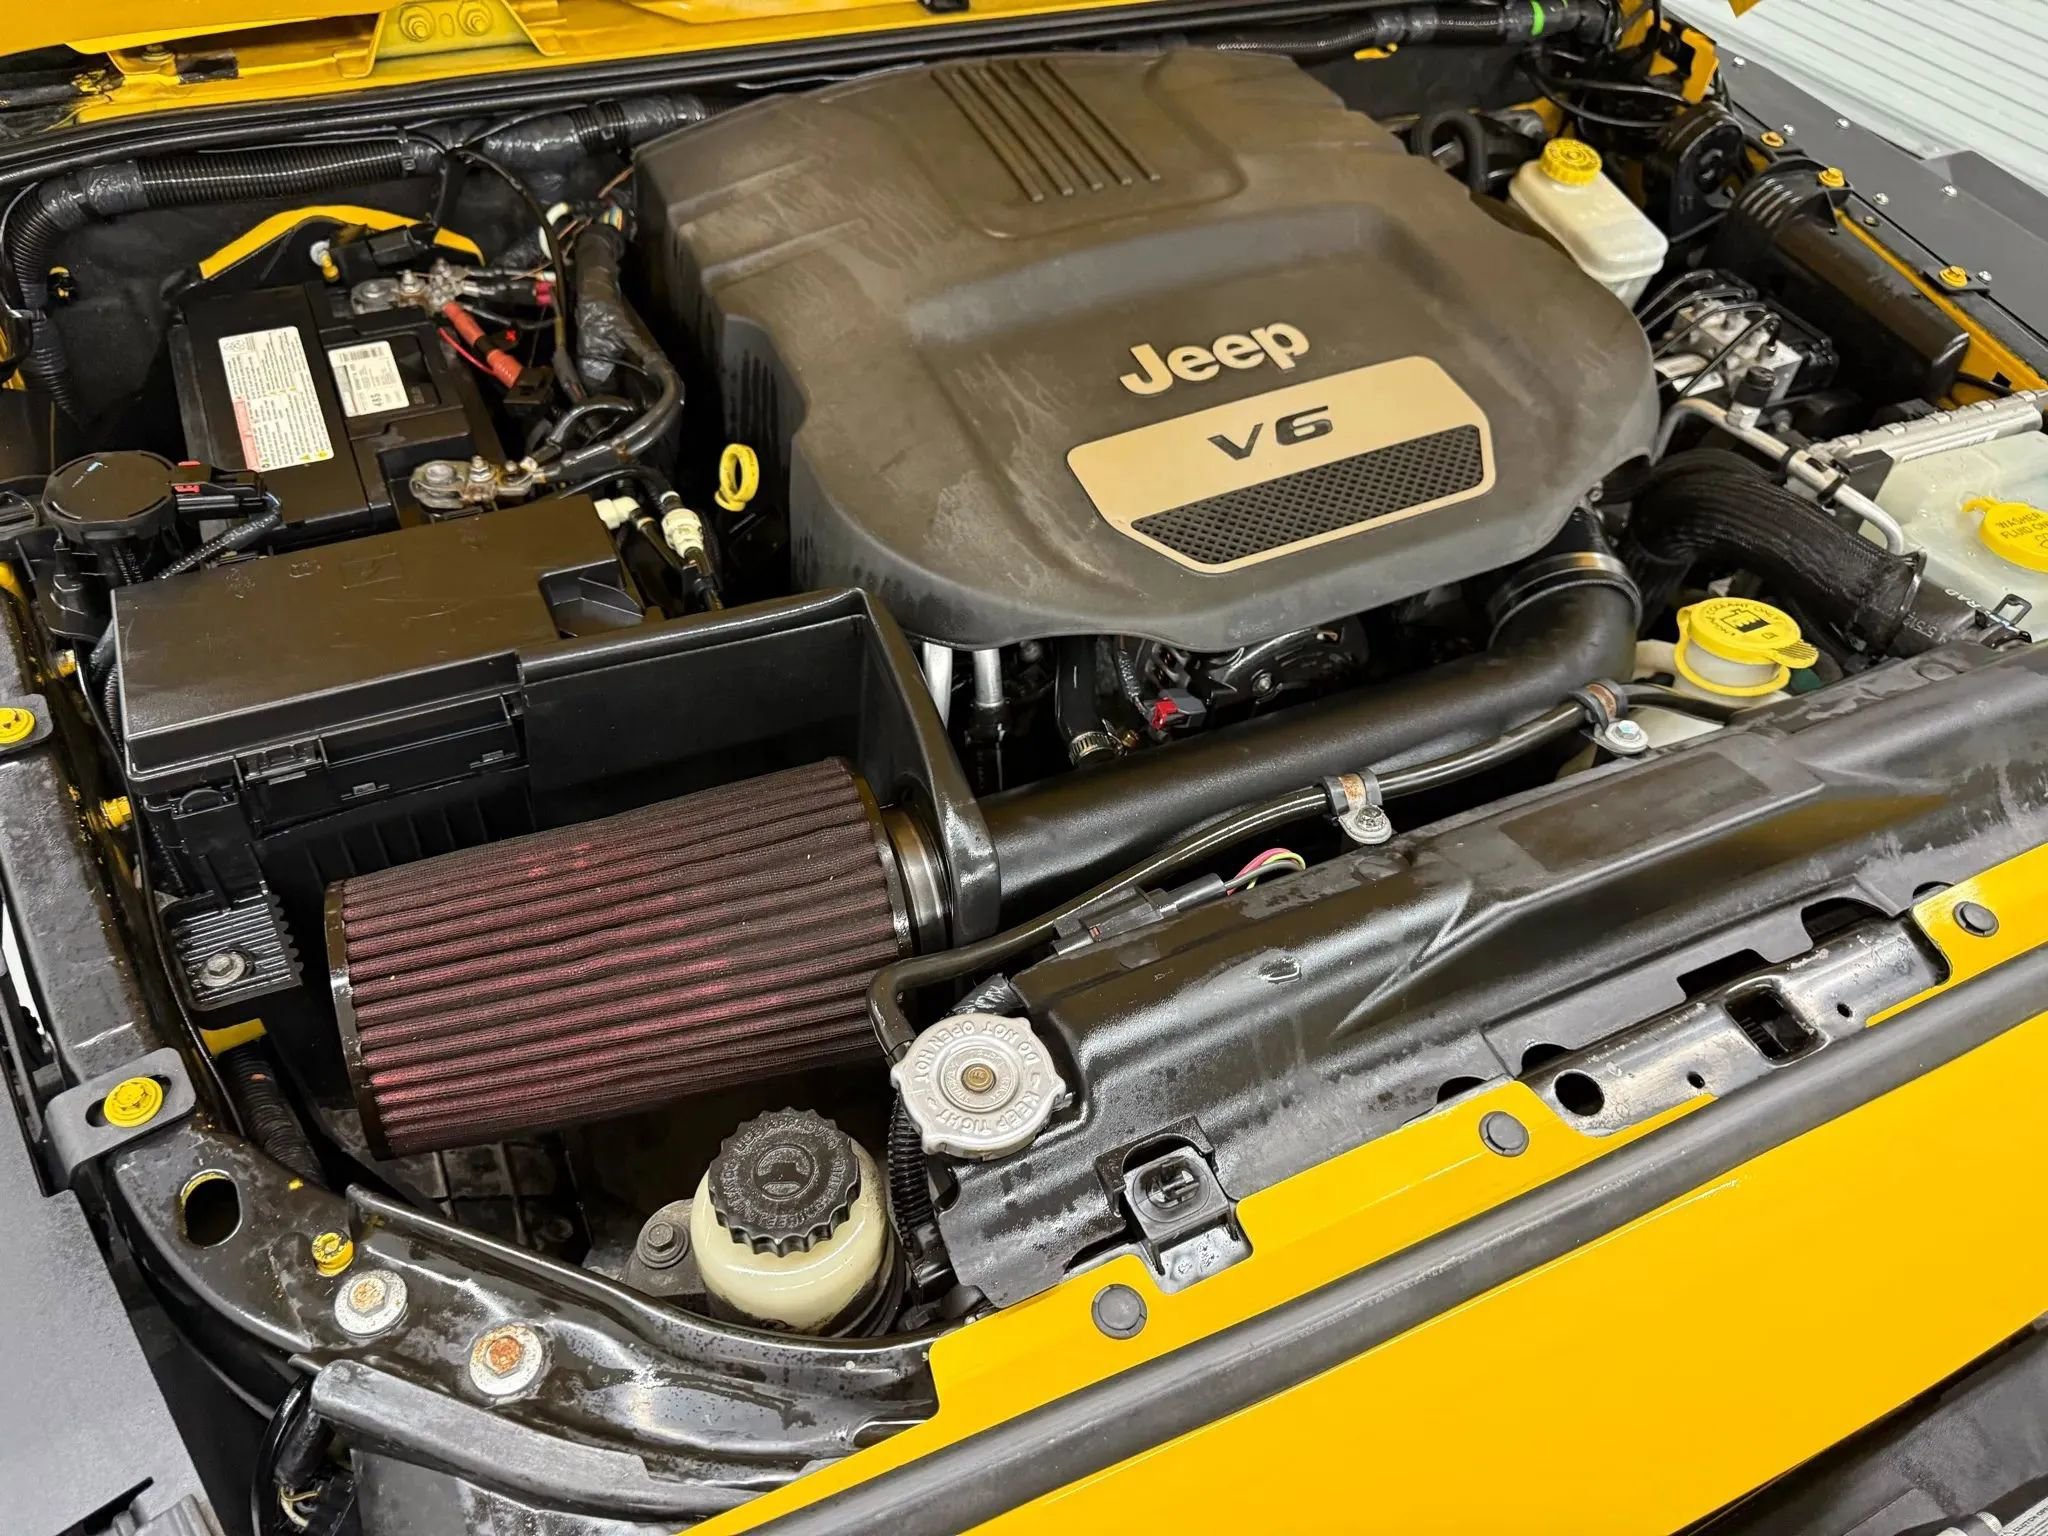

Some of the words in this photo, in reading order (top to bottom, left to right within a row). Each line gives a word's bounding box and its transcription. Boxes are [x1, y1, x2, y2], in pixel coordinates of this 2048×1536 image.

[1119, 321, 1310, 397] Jeep
[1207, 405, 1335, 461] V6
[1995, 512, 2043, 529] WASHER
[2000, 526, 2033, 539] FLUID
[1945, 588, 1982, 608] RAD
[928, 1021, 975, 1051] OPEN
[981, 1021, 1020, 1044] NOT
[914, 1051, 936, 1084] HOT
[1019, 1041, 1040, 1066] DO
[935, 1108, 992, 1136] TIGHT
[997, 1090, 1040, 1132] KEEP
